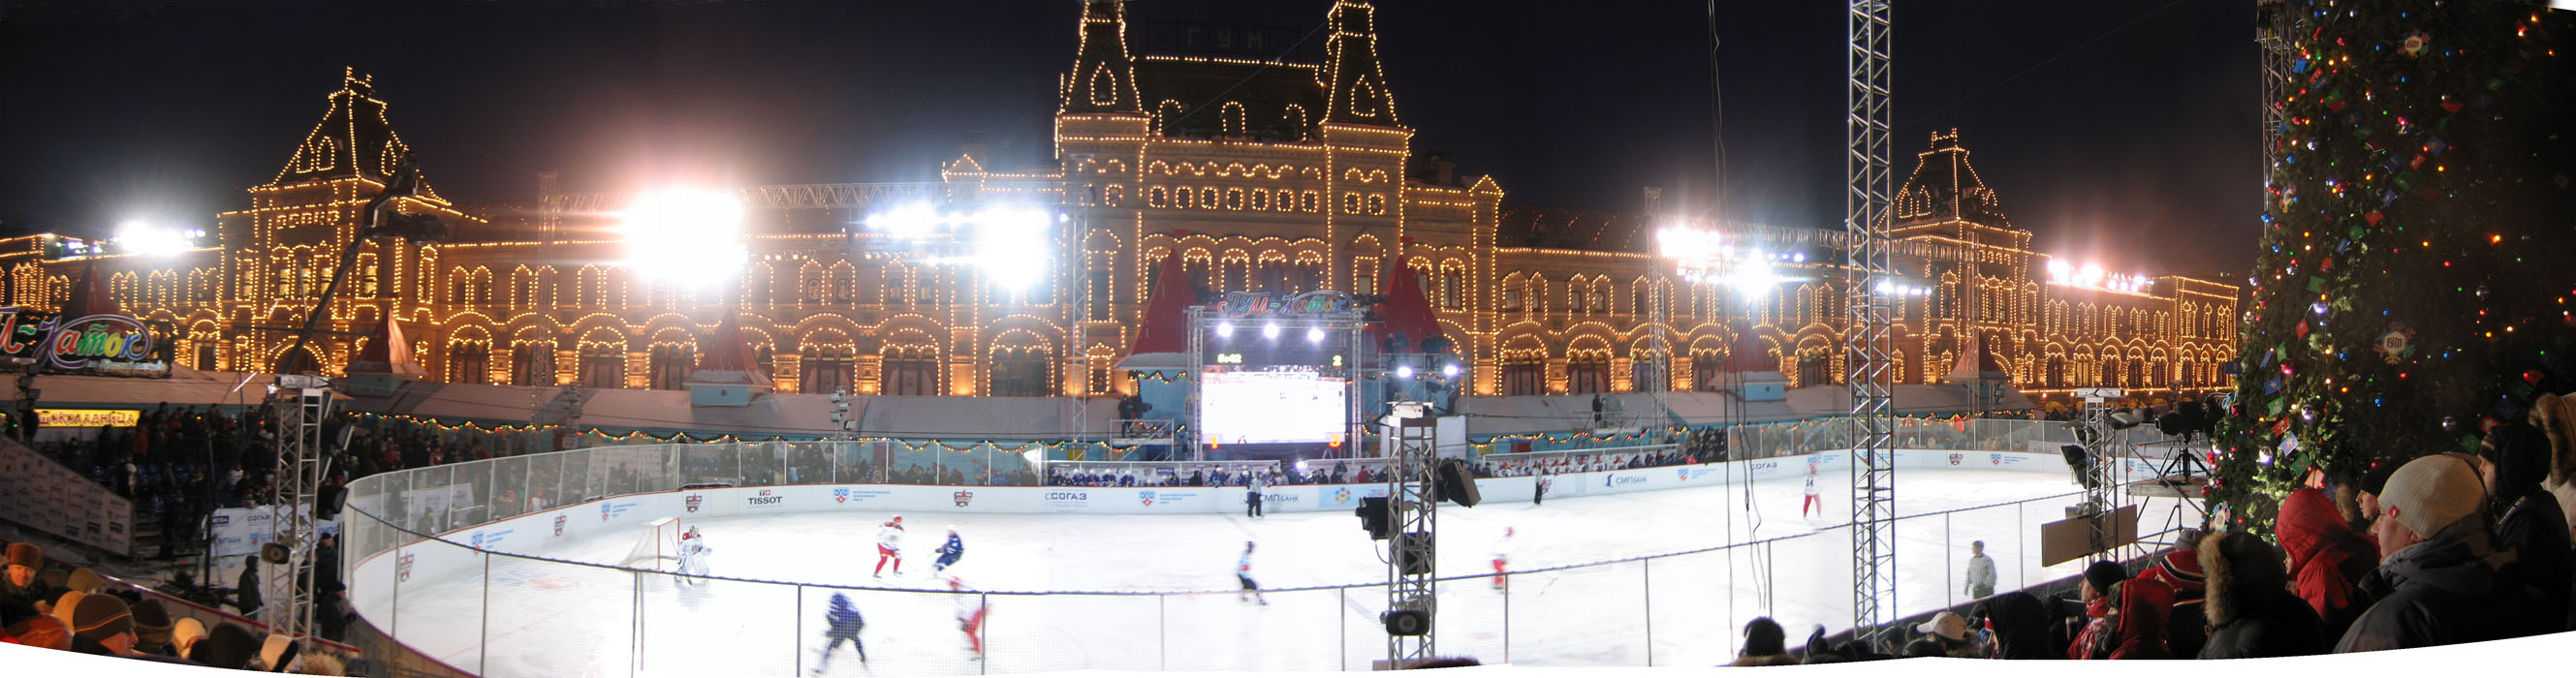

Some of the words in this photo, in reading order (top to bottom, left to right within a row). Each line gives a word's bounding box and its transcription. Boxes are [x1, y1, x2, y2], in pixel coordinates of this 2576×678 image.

[1186, 28, 1263, 50] ГУМ
[1332, 354, 1342, 366] 2
[40, 412, 135, 425] ШОКОЛАДНИЦА
[1329, 434, 1341, 447] 3
[748, 496, 783, 505] TISSOT
